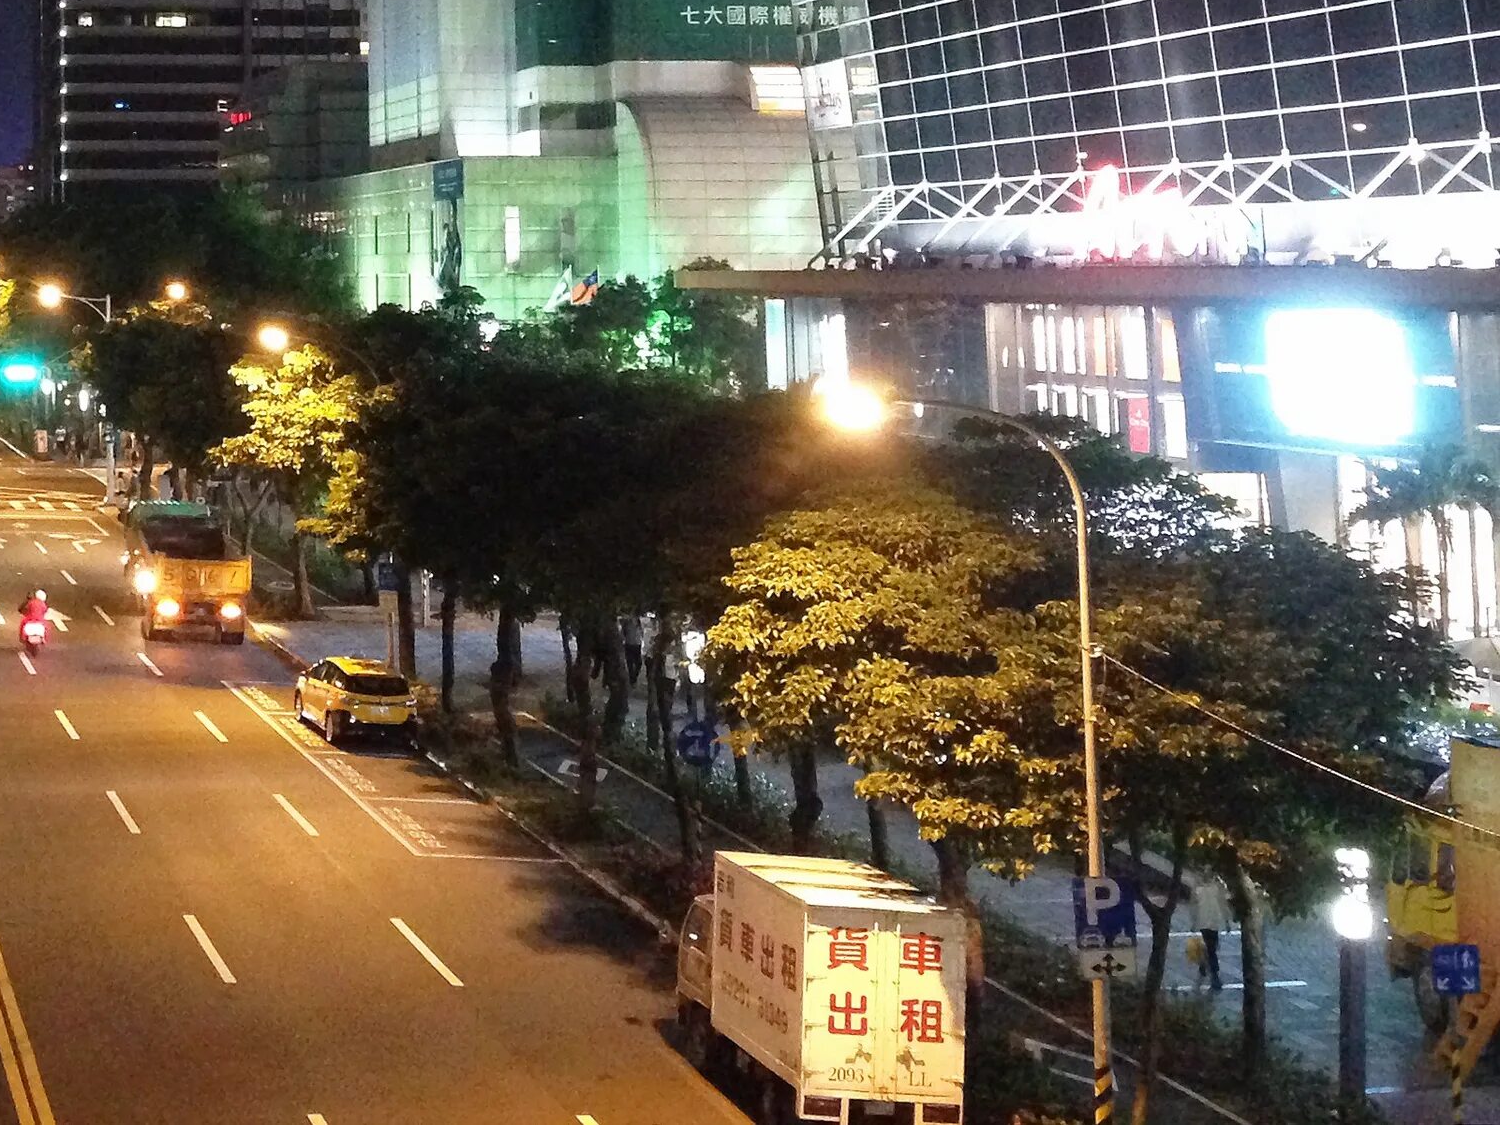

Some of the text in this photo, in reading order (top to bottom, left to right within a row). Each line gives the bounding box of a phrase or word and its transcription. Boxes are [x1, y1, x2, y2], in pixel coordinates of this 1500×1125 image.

[1084, 878, 1120, 925] P
[827, 926, 944, 975] 貨車
[827, 991, 944, 1043] 出租
